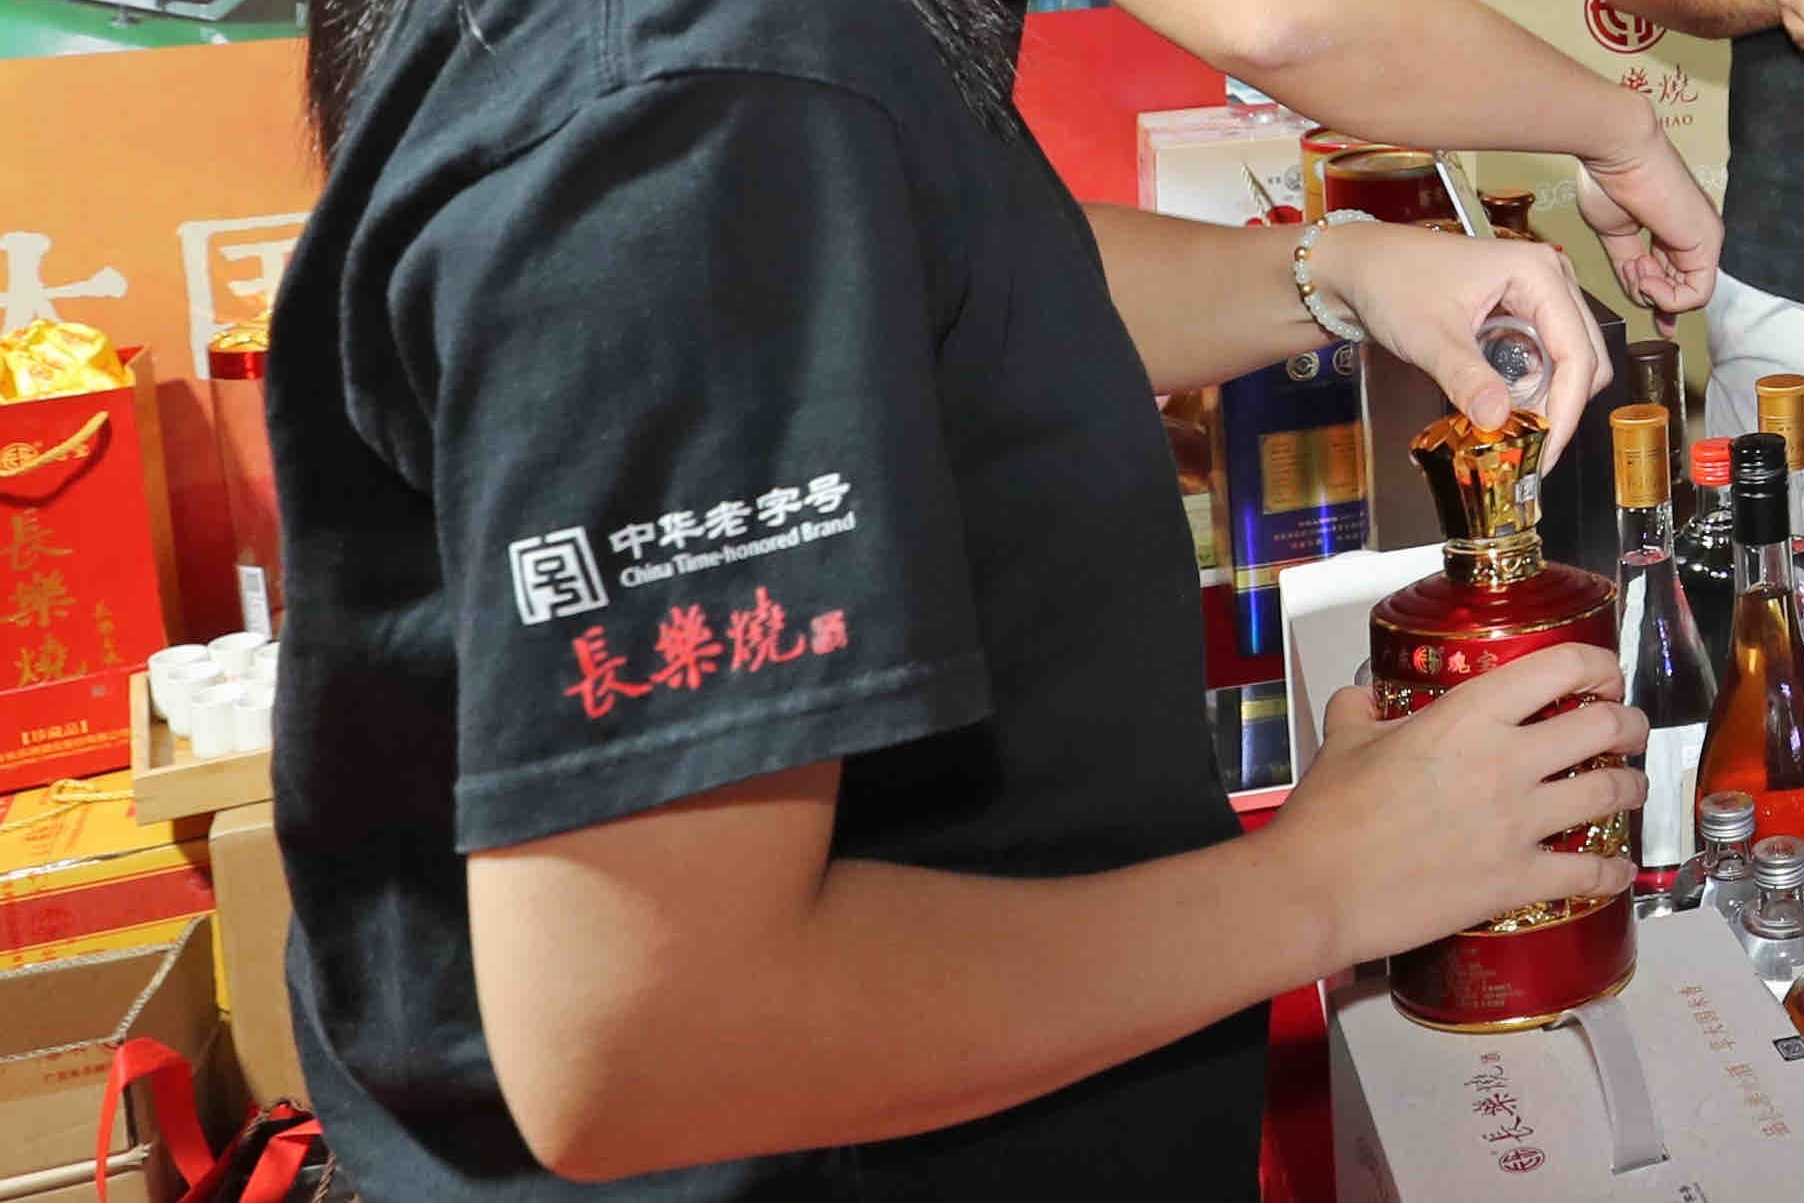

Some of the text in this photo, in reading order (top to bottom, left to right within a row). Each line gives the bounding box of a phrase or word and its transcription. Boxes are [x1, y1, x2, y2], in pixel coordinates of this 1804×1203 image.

[609, 471, 852, 560] 中华老字号
[619, 510, 857, 589] China Time-honored Brand
